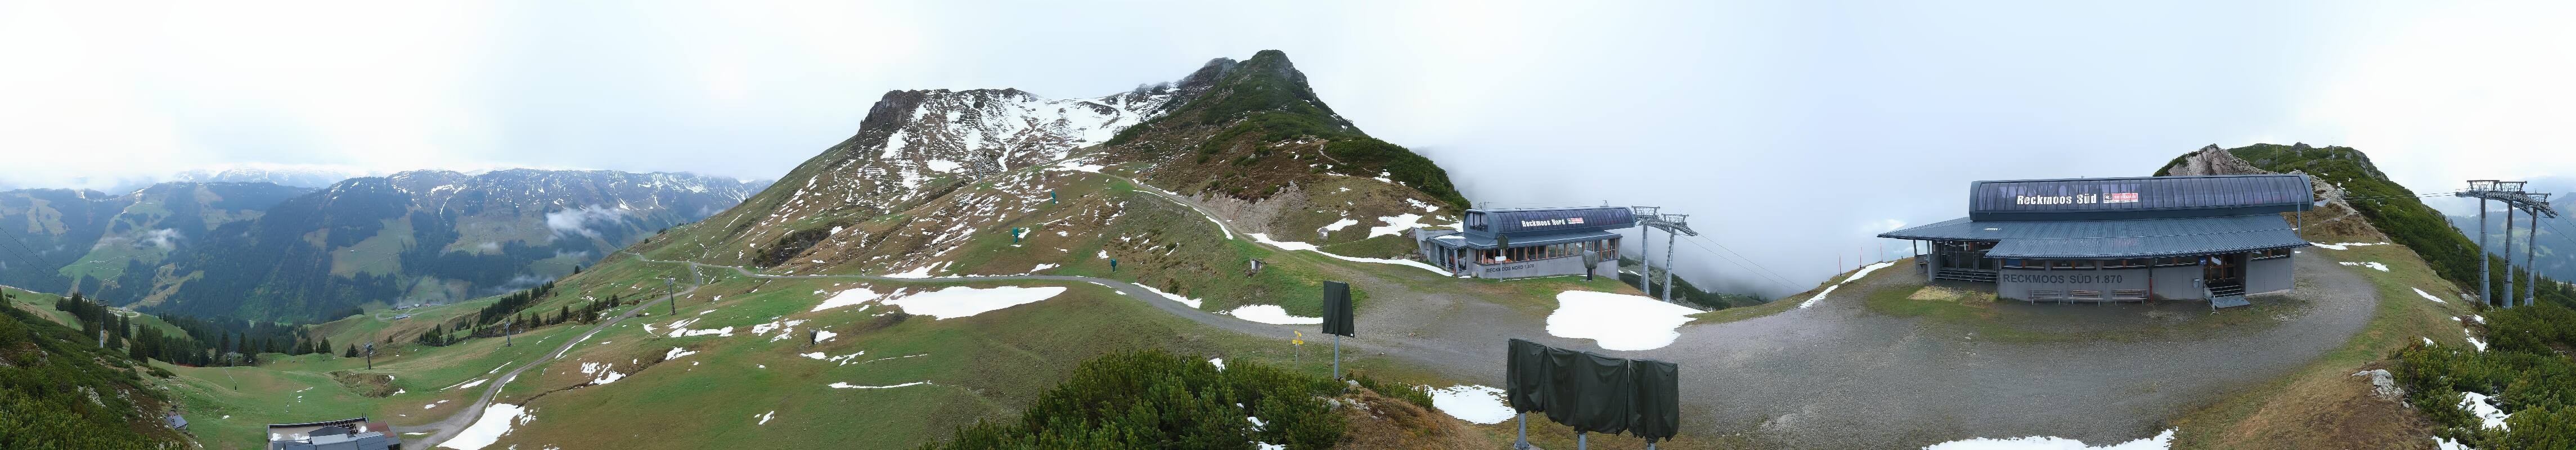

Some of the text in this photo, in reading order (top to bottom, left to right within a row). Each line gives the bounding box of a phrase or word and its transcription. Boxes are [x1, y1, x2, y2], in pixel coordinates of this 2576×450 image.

[2017, 193, 2097, 205] Reckmoos Süd
[2003, 274, 2123, 284] RECKMOOS SÜD 1.870
